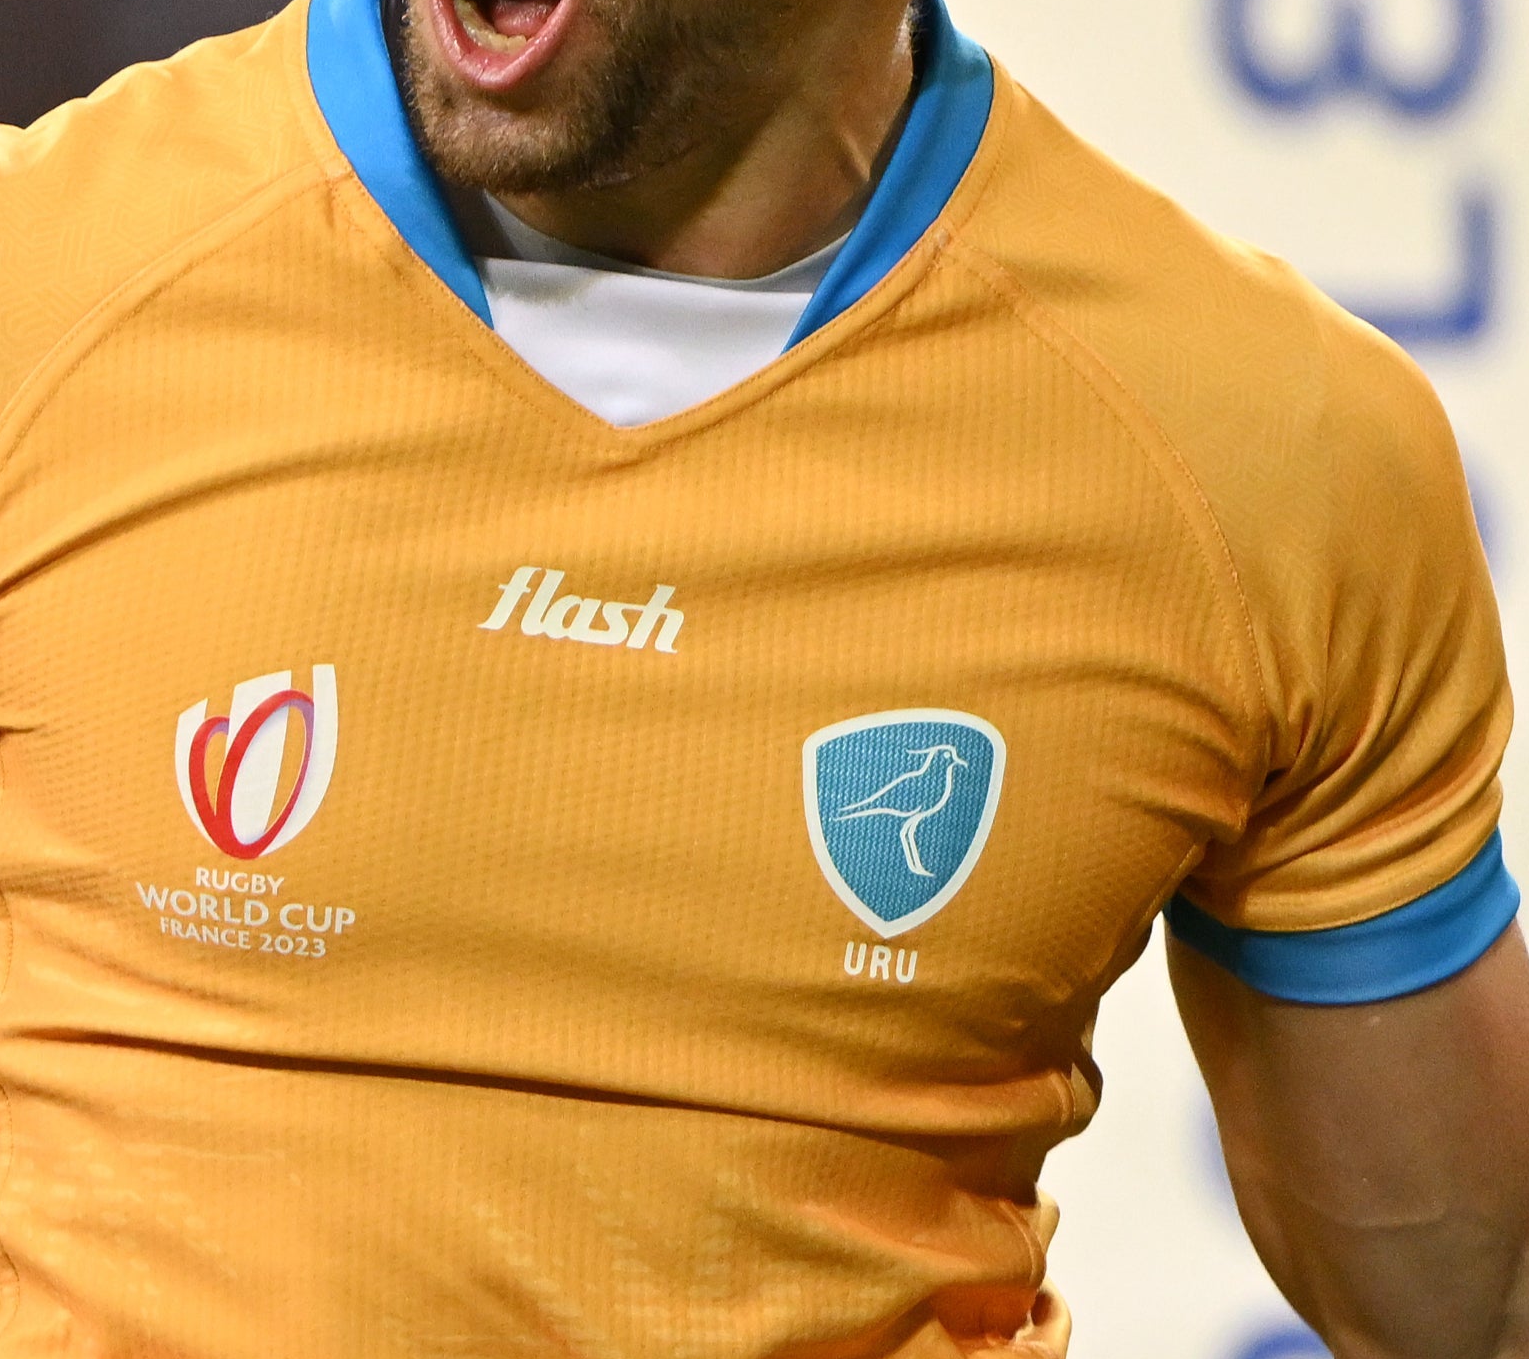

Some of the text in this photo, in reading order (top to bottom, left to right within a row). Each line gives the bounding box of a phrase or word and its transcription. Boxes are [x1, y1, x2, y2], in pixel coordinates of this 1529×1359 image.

[476, 564, 686, 654] flash
[195, 866, 285, 896] RUGBY
[135, 881, 357, 935] WORLD CUP
[159, 916, 328, 959] FRANCE 2023
[843, 940, 919, 984] URU
